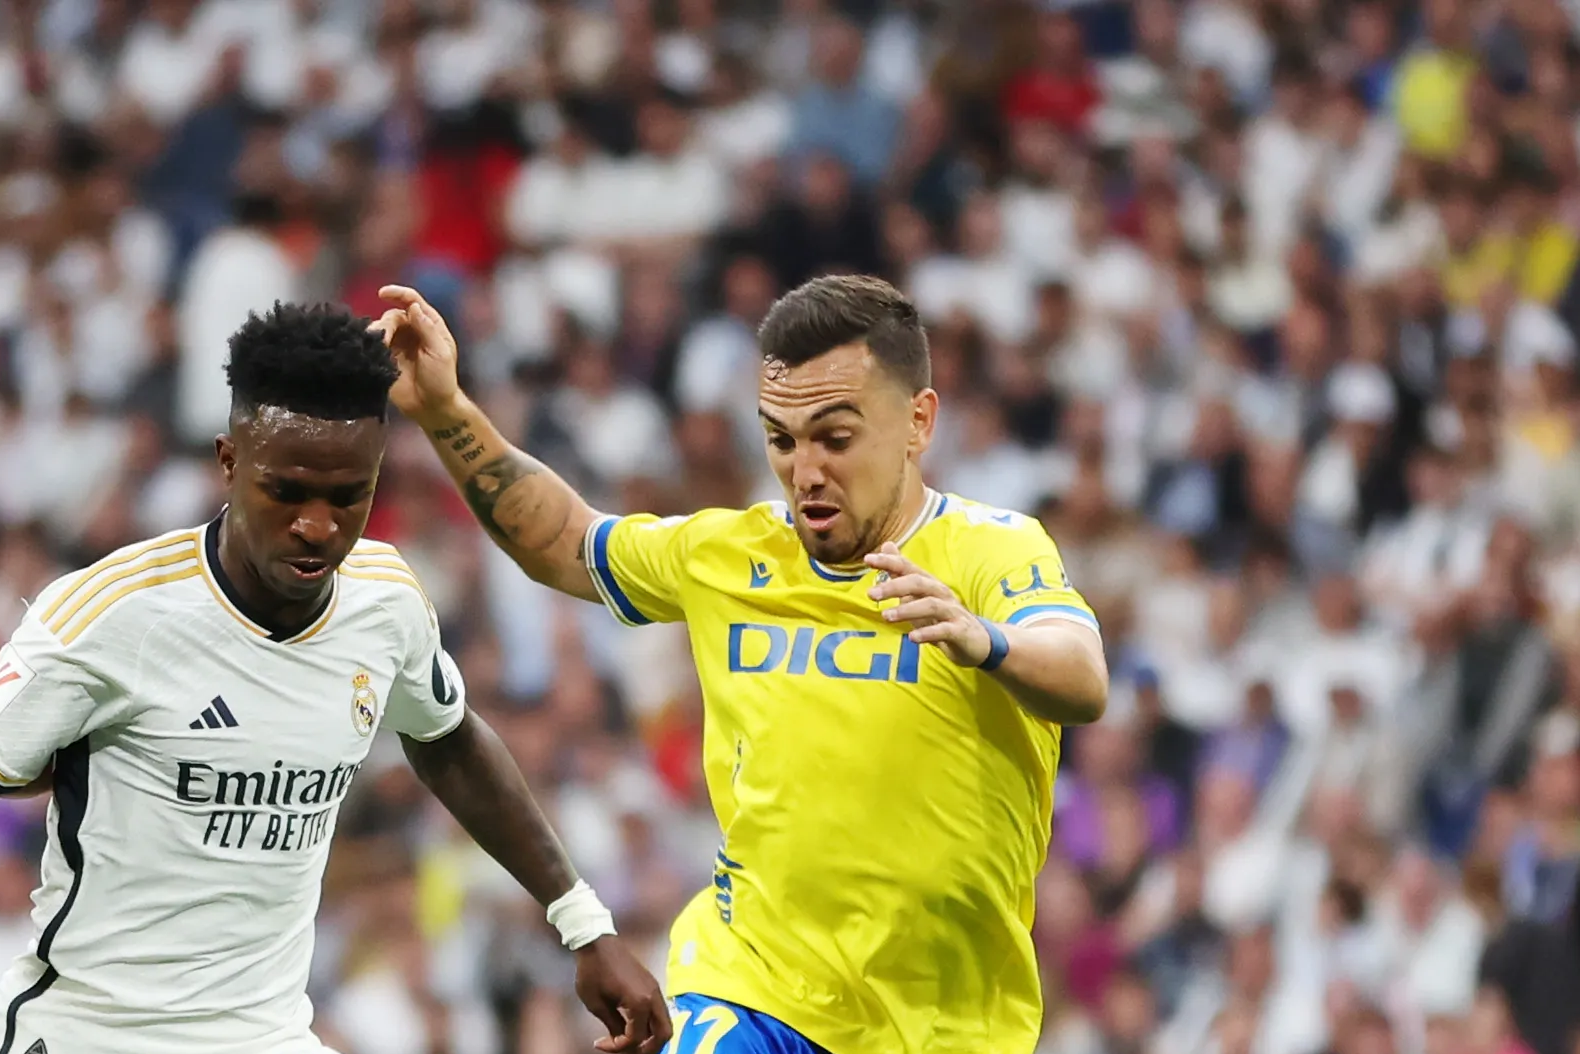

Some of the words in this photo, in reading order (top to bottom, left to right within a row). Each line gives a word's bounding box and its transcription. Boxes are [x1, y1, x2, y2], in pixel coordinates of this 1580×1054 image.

[728, 623, 919, 684] DIGI
[177, 760, 360, 806] Emirate
[203, 810, 257, 849] FLY
